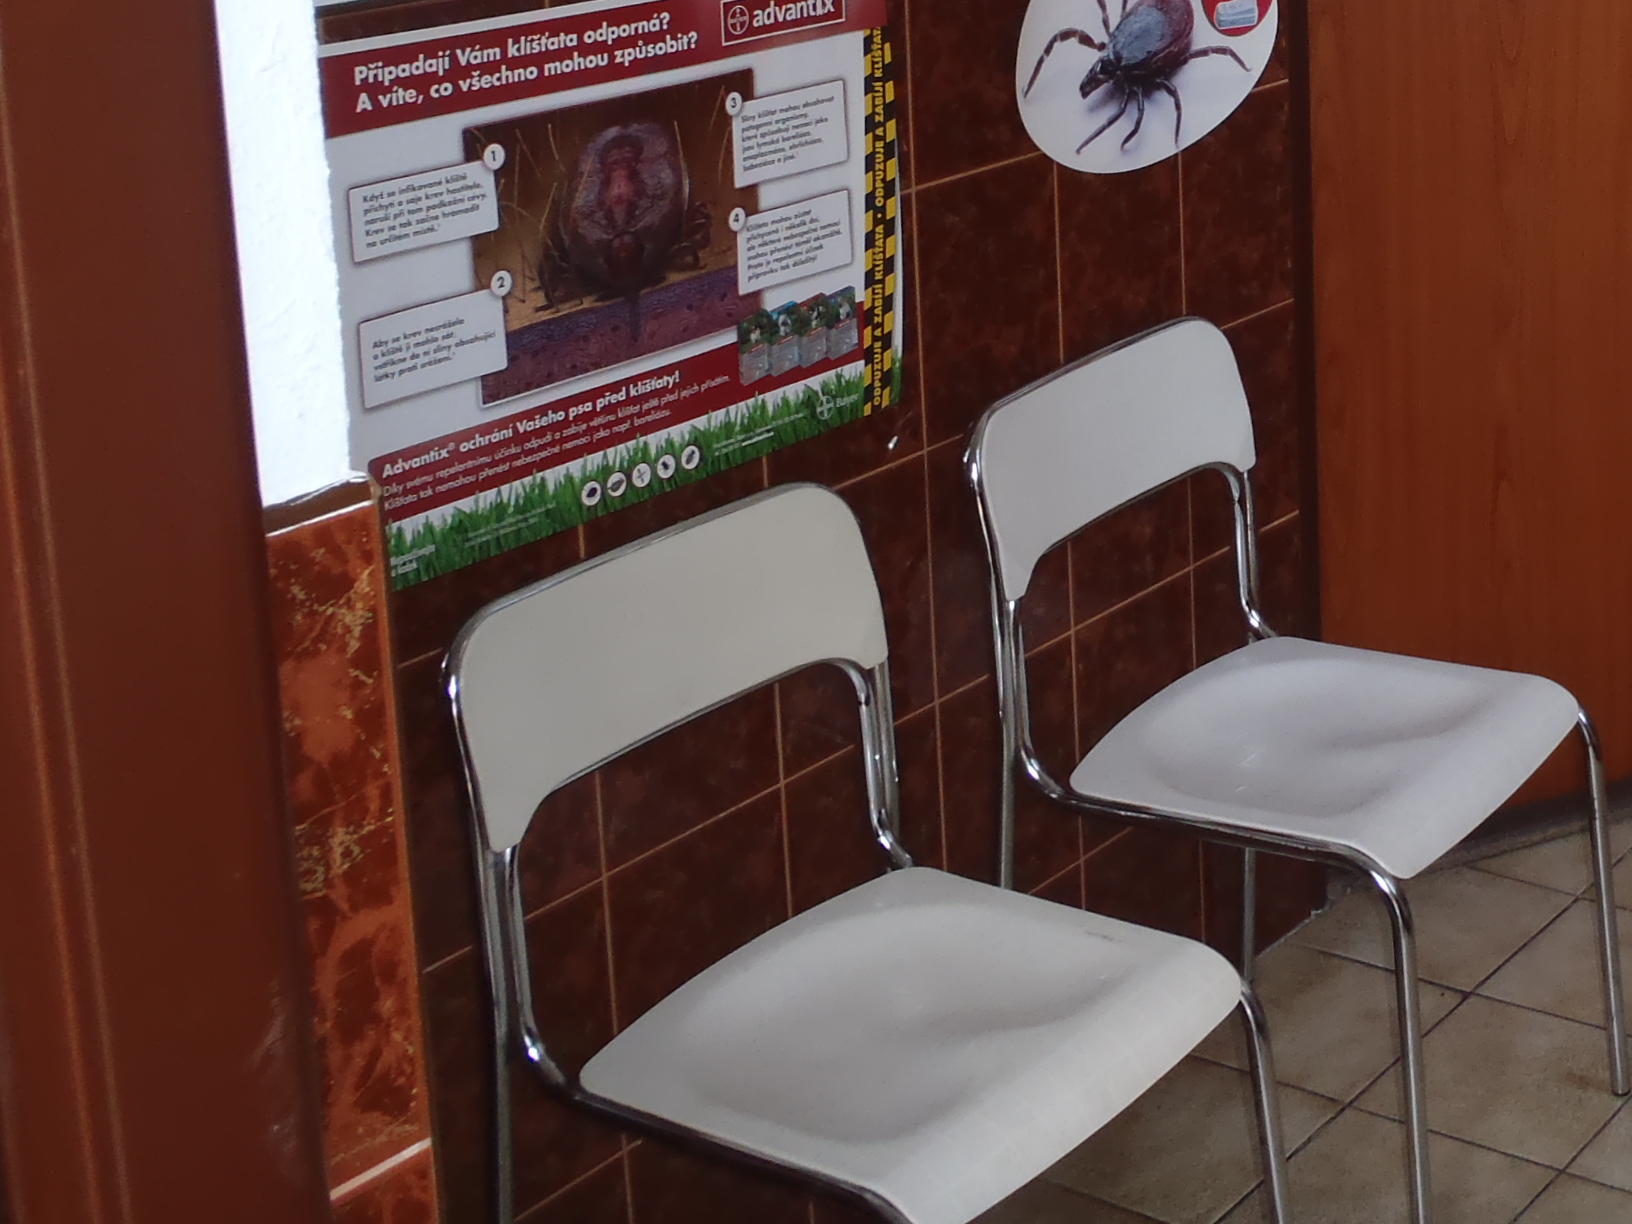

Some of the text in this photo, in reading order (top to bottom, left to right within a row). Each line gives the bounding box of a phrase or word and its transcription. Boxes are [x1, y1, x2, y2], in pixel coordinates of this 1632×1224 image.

[354, 12, 670, 86] Připadají Vám klíšťata odporná?
[356, 31, 698, 113] A víte, co všechno mohou způsobit?
[730, 97, 737, 109] 3
[875, 127, 884, 136] A
[491, 150, 496, 162] 1
[875, 141, 884, 207] ODPUZUJE
[733, 213, 740, 224] 4
[497, 277, 505, 289] 2
[874, 327, 882, 336] A
[873, 341, 883, 406] ODPUZUJE
[459, 423, 513, 452] ochrání
[516, 410, 566, 434] Vašeho
[569, 401, 593, 420] psa
[596, 387, 626, 411] před
[629, 370, 680, 398] klíšťaty!
[419, 485, 434, 498] tak
[436, 471, 477, 493] nemohou
[562, 435, 591, 450] nemoci
[593, 428, 611, 442] jako
